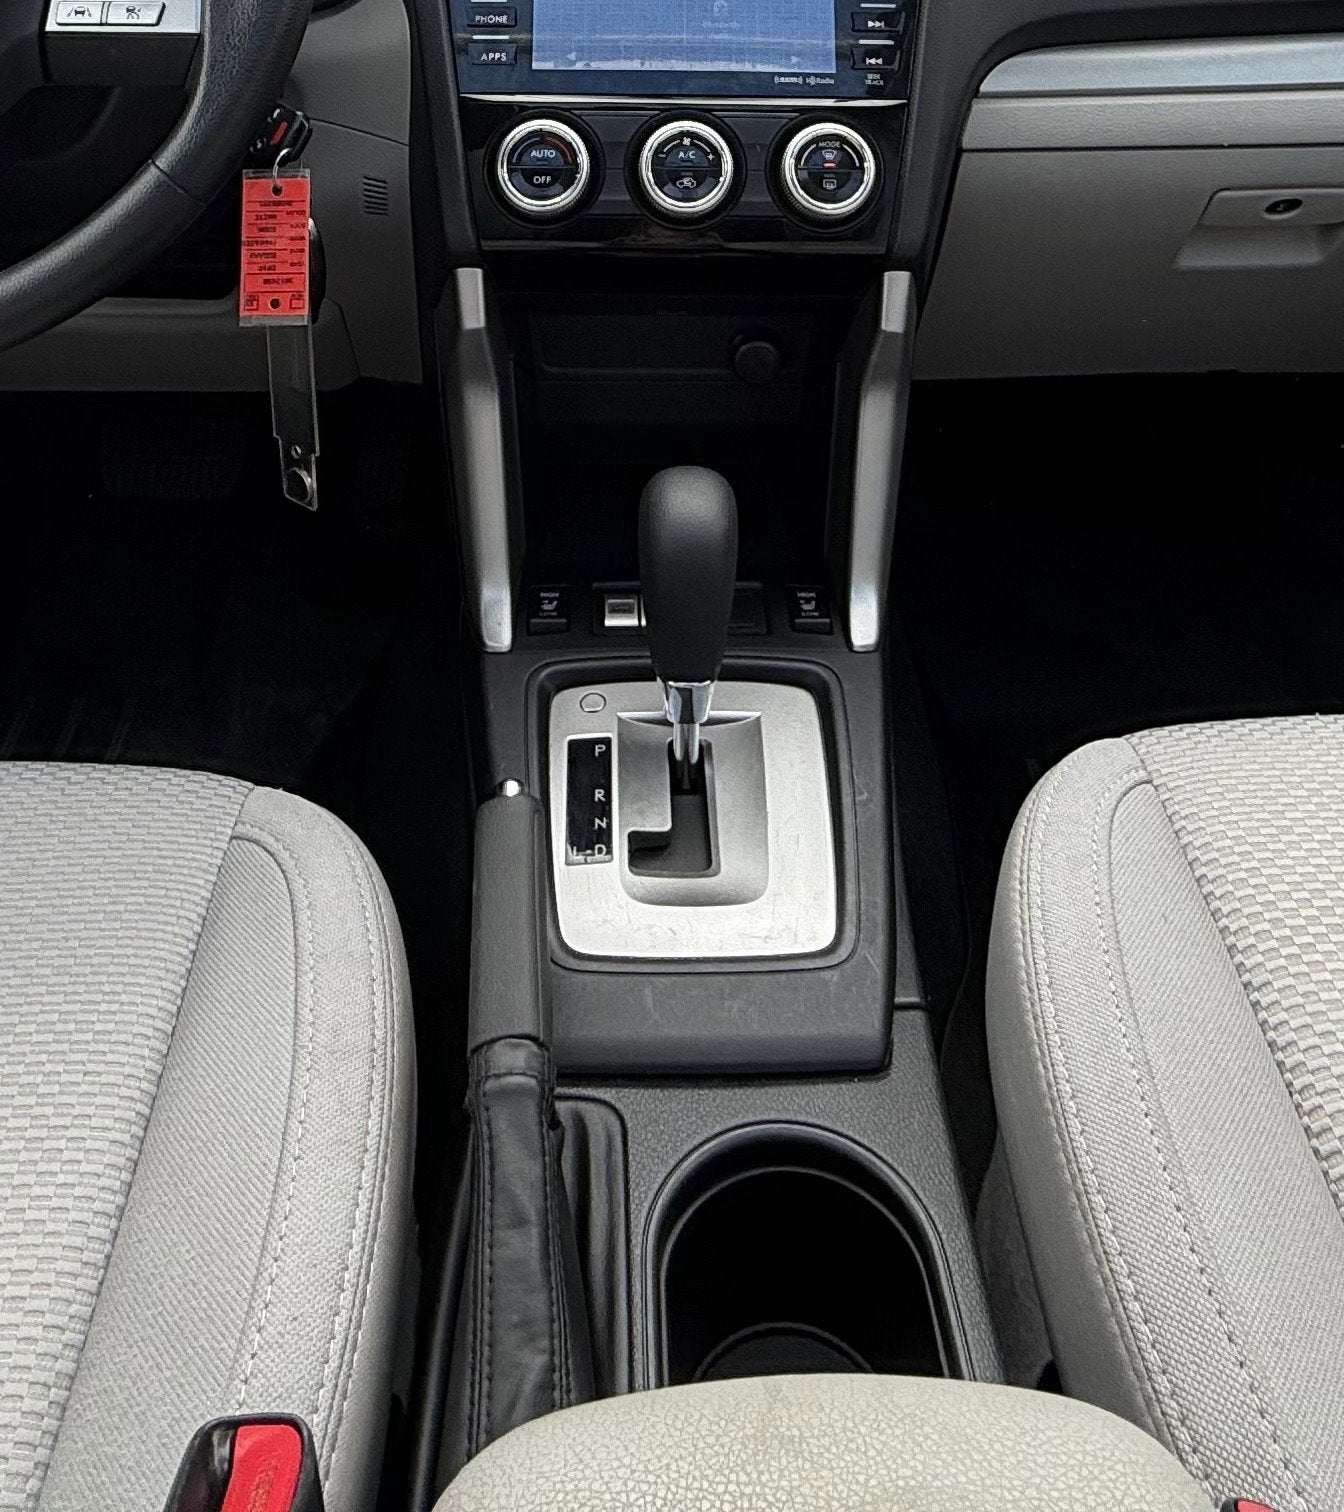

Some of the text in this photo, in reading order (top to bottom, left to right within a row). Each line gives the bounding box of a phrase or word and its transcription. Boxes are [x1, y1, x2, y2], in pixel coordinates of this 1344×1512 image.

[474, 14, 508, 24] PHONE
[480, 52, 508, 63] APPS
[530, 148, 557, 159] AUTO
[678, 149, 696, 161] A/C
[532, 175, 553, 185] OFF
[594, 744, 606, 757] P
[594, 789, 605, 802] R
[594, 817, 607, 830] N
[594, 844, 607, 858] D
